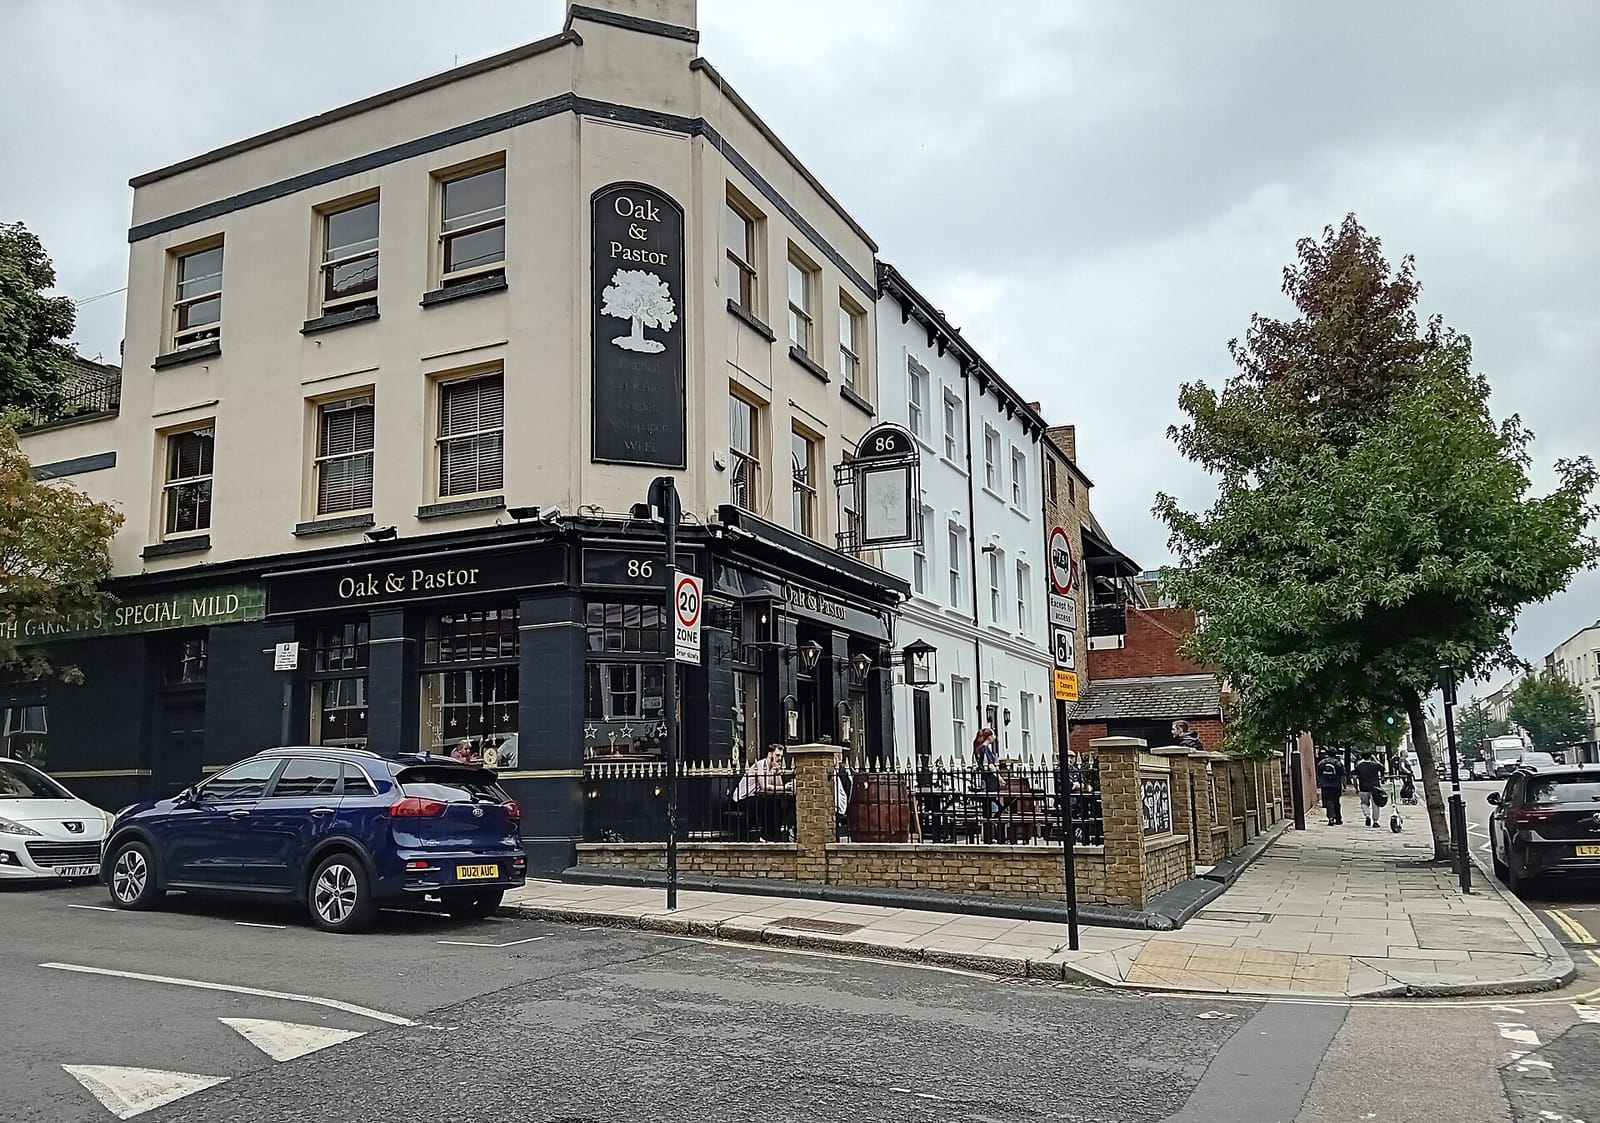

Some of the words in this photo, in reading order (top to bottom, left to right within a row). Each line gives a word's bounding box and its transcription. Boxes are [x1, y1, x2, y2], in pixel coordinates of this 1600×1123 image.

[615, 196, 661, 222] Oak
[628, 223, 648, 240] &
[609, 241, 668, 266] Pastor
[875, 436, 895, 452] 86
[627, 559, 653, 578] 86
[338, 573, 380, 598] Oak
[385, 572, 406, 593] &
[411, 568, 480, 591] Pastor
[114, 600, 182, 626] SPECIAL
[191, 594, 239, 618] MILD
[680, 591, 697, 613] 20
[784, 583, 805, 608] Oak
[806, 591, 818, 611] &
[818, 594, 847, 620] Pastor
[676, 627, 698, 644] ZONE
[461, 866, 479, 878] DU21
[480, 865, 494, 876] AUC
